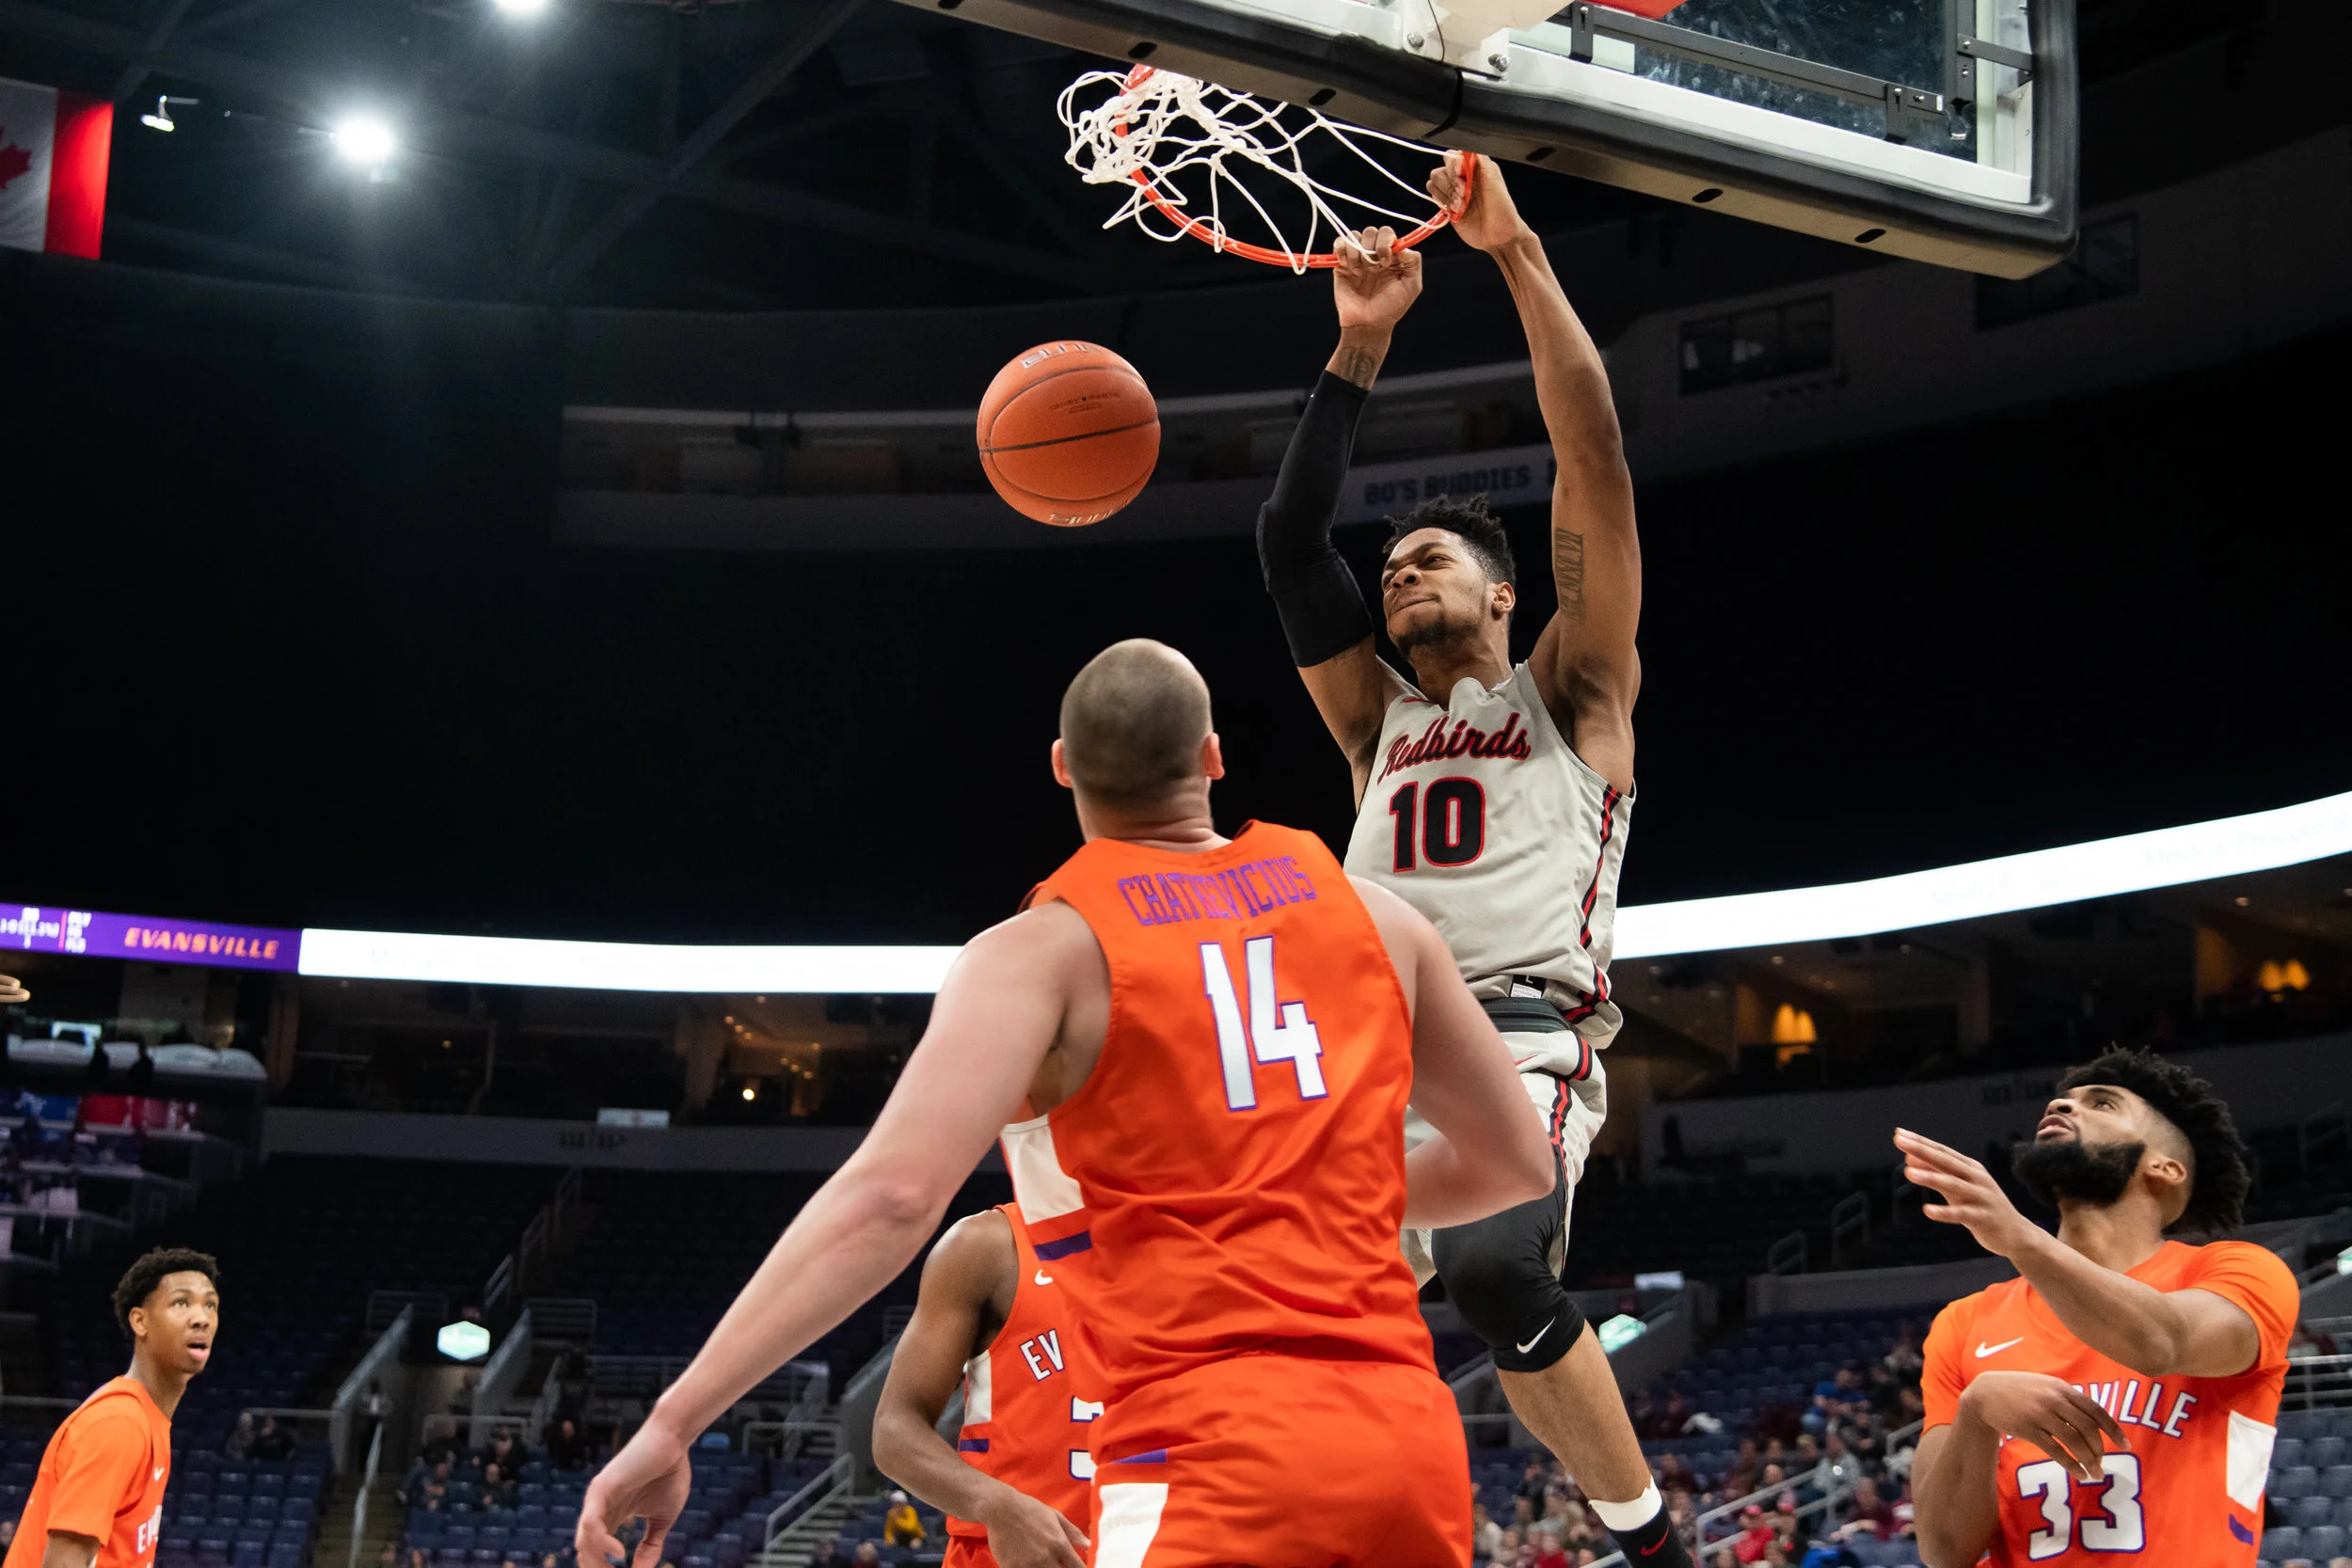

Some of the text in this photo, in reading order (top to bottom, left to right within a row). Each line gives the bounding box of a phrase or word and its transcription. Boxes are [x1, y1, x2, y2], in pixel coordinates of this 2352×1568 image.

[1378, 712, 1532, 785] Redbirds
[1390, 776, 1486, 873] 10
[124, 927, 279, 959] EVANSVILLE
[1199, 934, 1328, 1112] 14
[2016, 1452, 2146, 1561] 33
